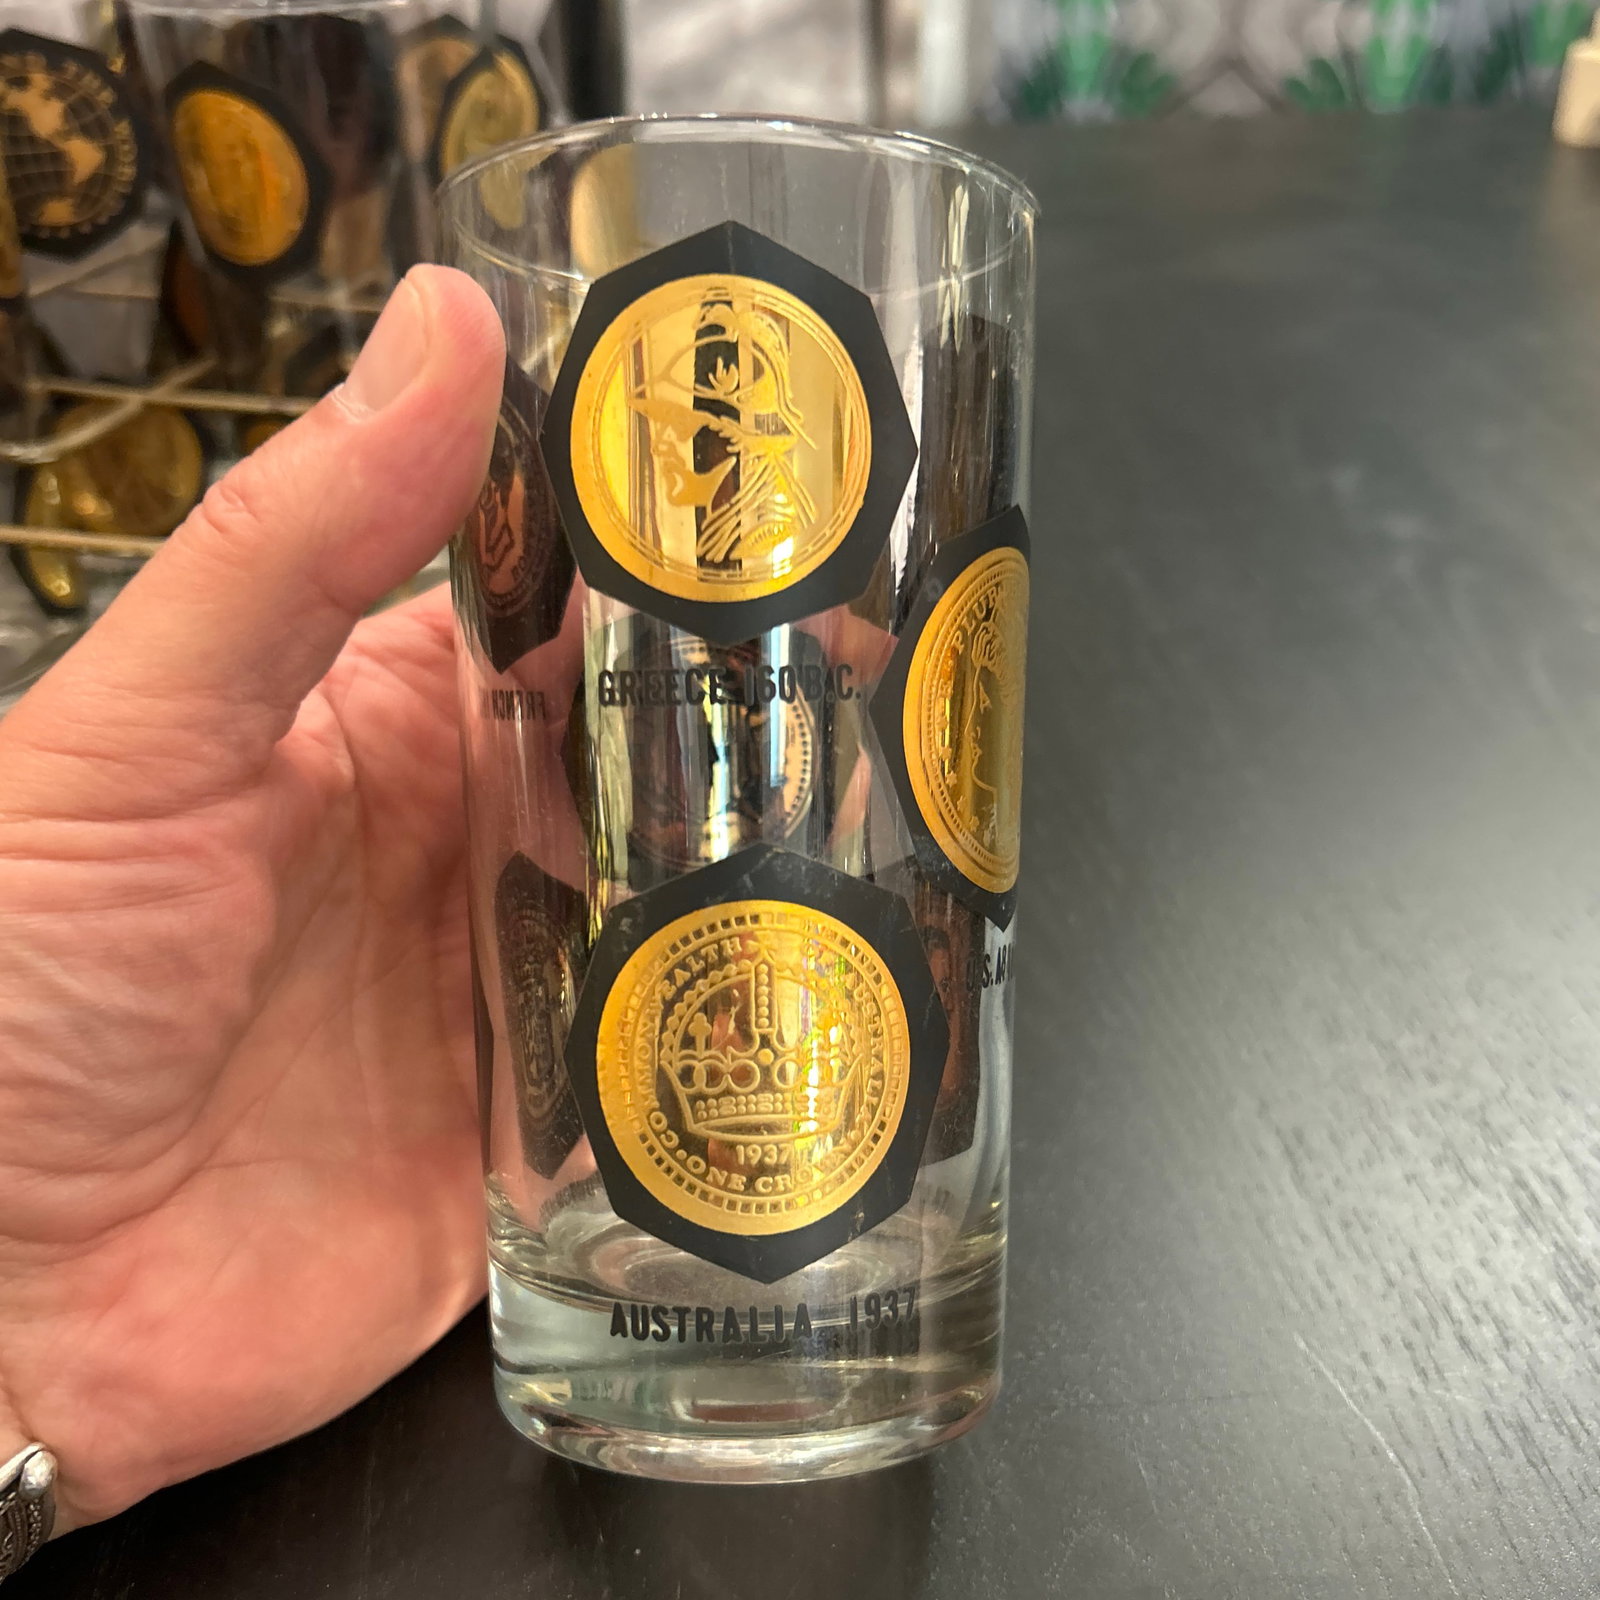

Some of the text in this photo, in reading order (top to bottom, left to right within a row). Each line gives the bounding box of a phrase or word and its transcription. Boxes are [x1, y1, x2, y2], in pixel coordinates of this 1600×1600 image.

[598, 668, 727, 707] GREECE
[686, 1154, 748, 1193] ONE
[735, 1143, 792, 1168] 1937
[610, 1285, 917, 1344] AUSTRALIA 1937
